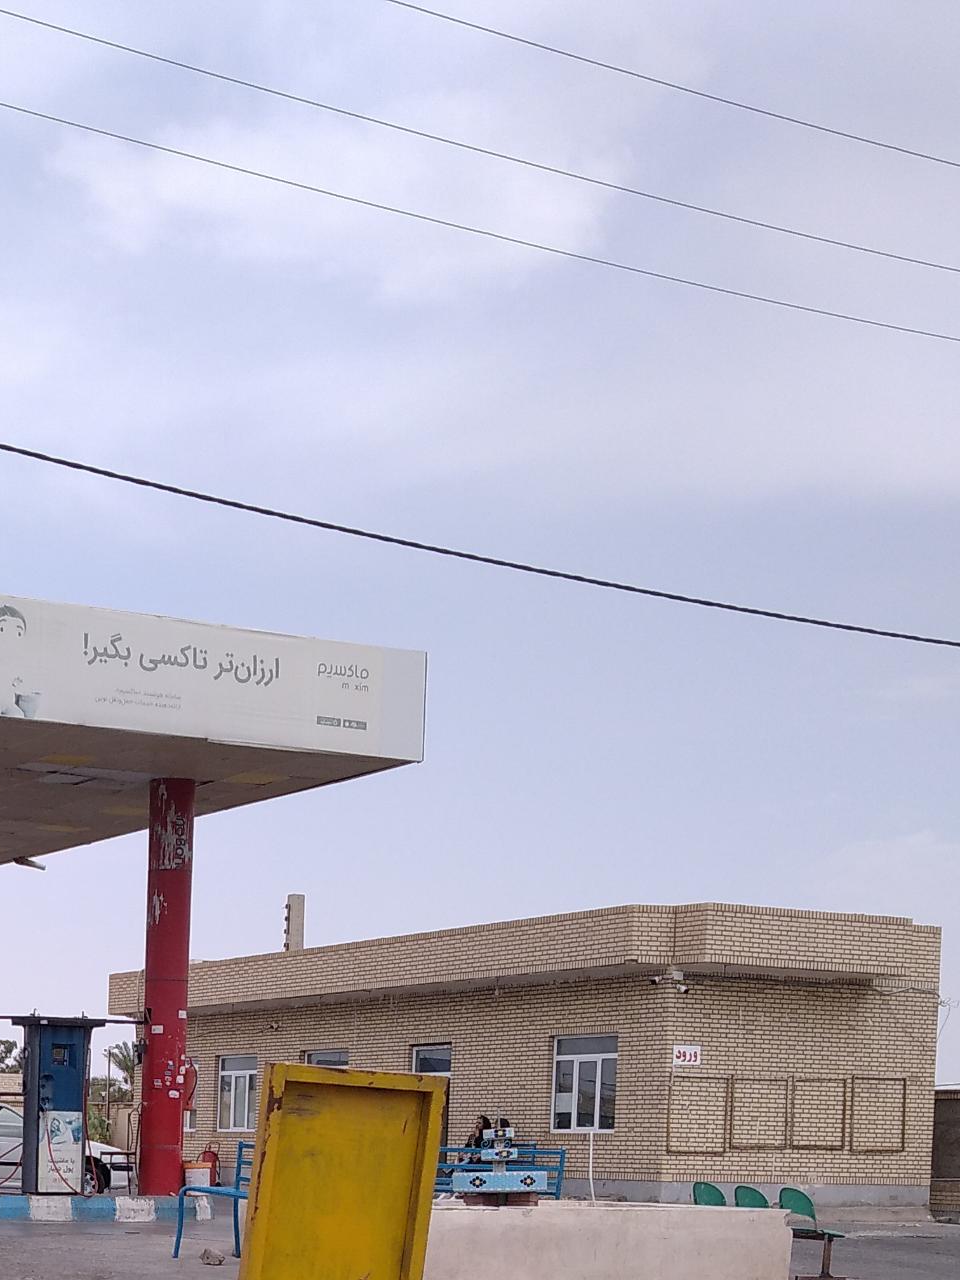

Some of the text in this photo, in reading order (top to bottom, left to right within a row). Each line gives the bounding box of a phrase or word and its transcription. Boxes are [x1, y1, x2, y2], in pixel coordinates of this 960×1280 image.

[83, 633, 131, 667] بگیر!
[139, 645, 207, 672] تاکسی
[318, 662, 369, 679] ماکسیم
[675, 1049, 698, 1062] ورود
